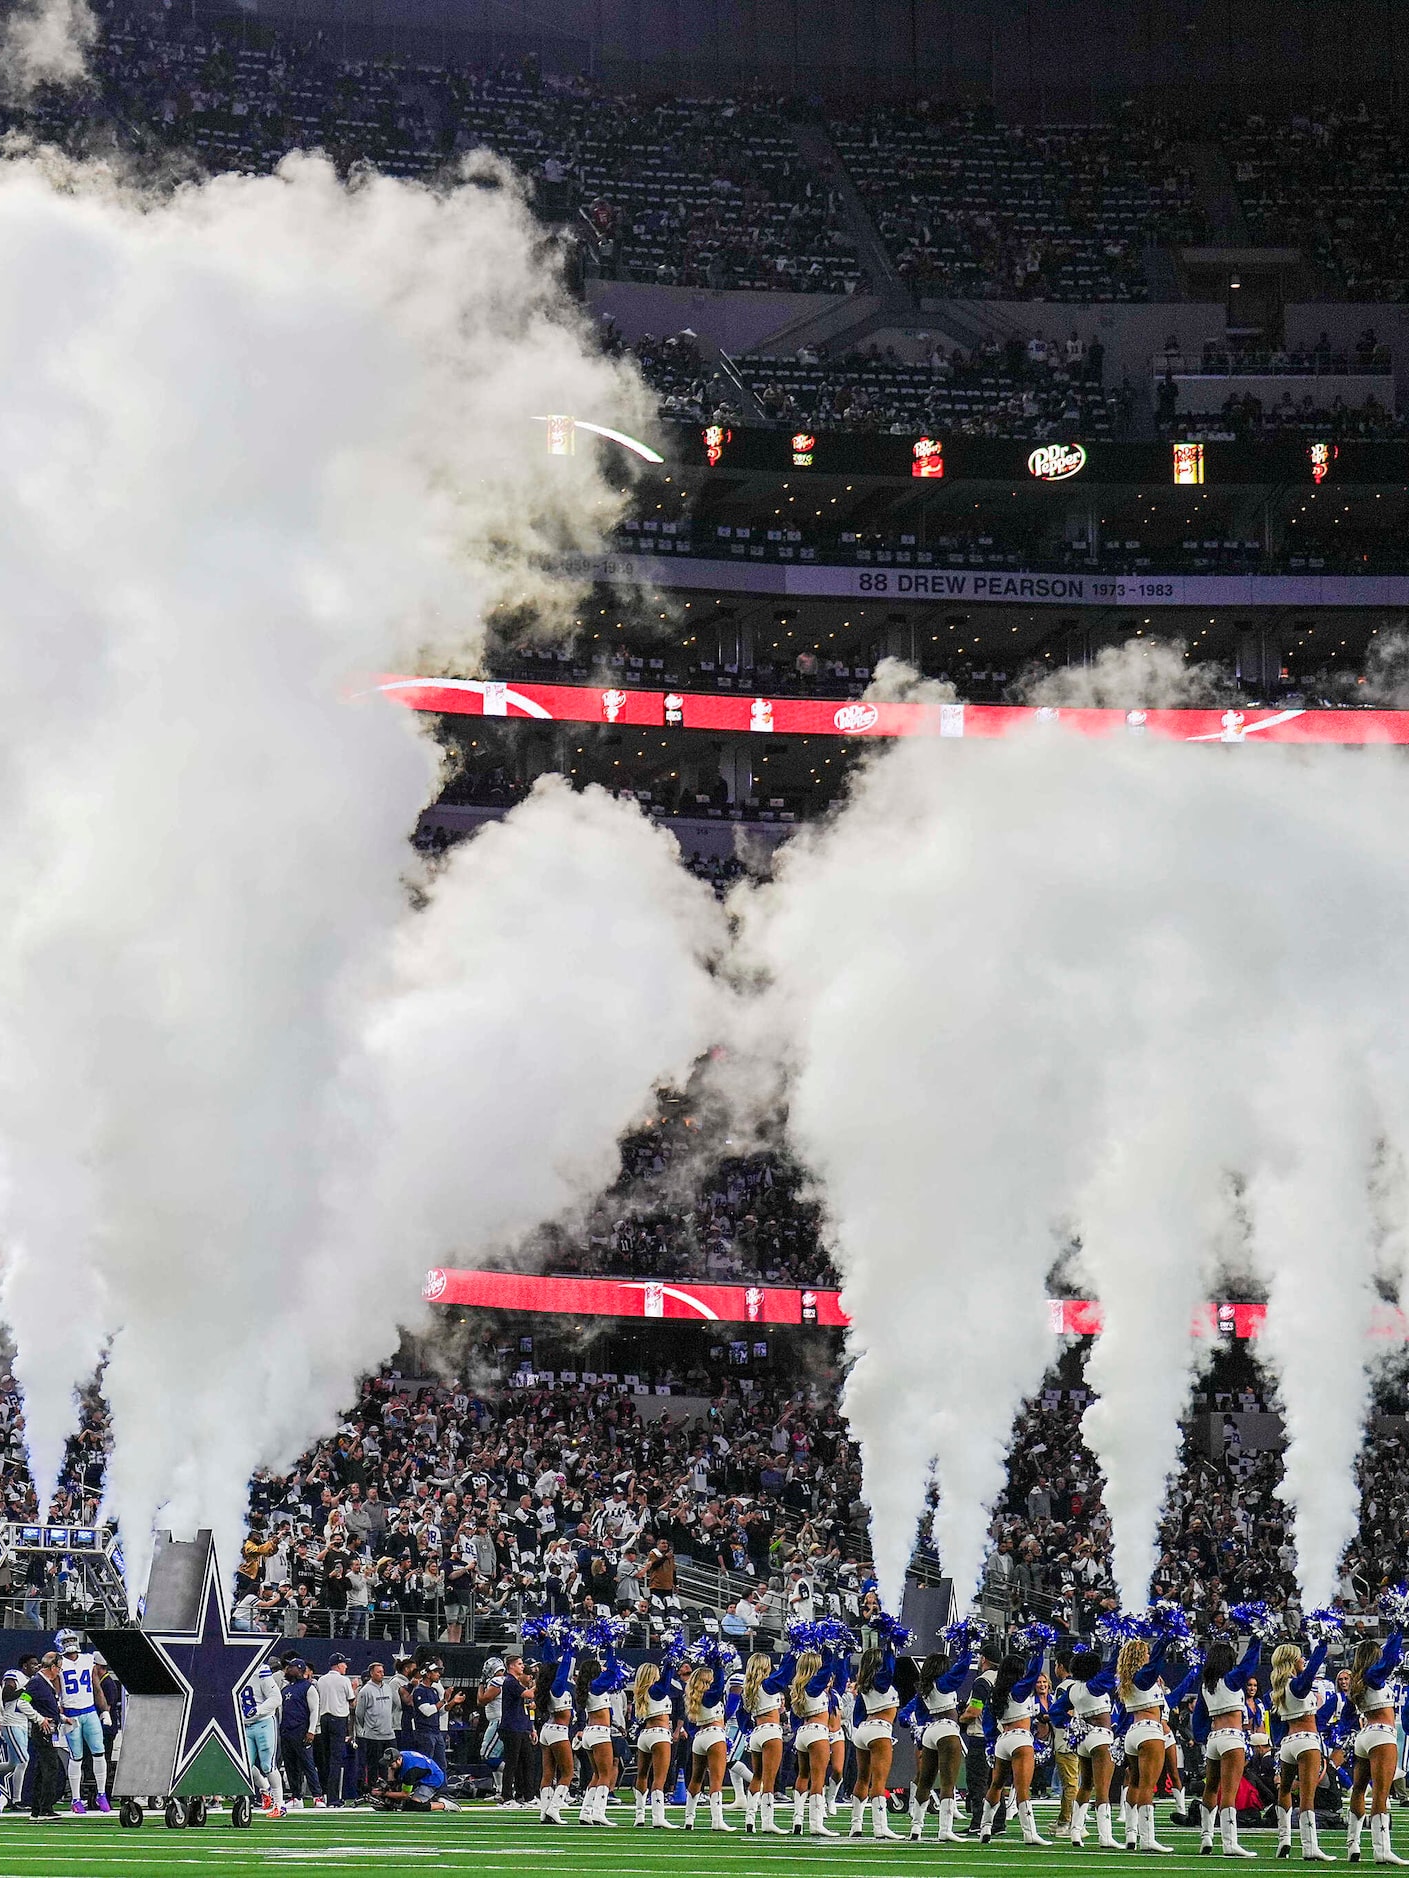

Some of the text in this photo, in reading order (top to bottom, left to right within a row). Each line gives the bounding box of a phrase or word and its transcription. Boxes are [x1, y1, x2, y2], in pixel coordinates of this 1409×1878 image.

[1048, 444, 1069, 460] Dr
[1031, 447, 1081, 476] Pepper
[859, 573, 888, 591] 88
[898, 574, 966, 594] DREW
[974, 575, 1084, 598] PEARSON
[848, 705, 865, 715] Dr
[836, 708, 875, 729] Pepper
[620, 1239, 629, 1251] 11
[428, 1269, 438, 1282] Dr
[4, 1395, 18, 1408] 12
[697, 1463, 704, 1475] 11
[801, 1484, 811, 1495] 11
[761, 1510, 771, 1521] 11
[1160, 1569, 1170, 1582] 11
[63, 1669, 93, 1695] 54
